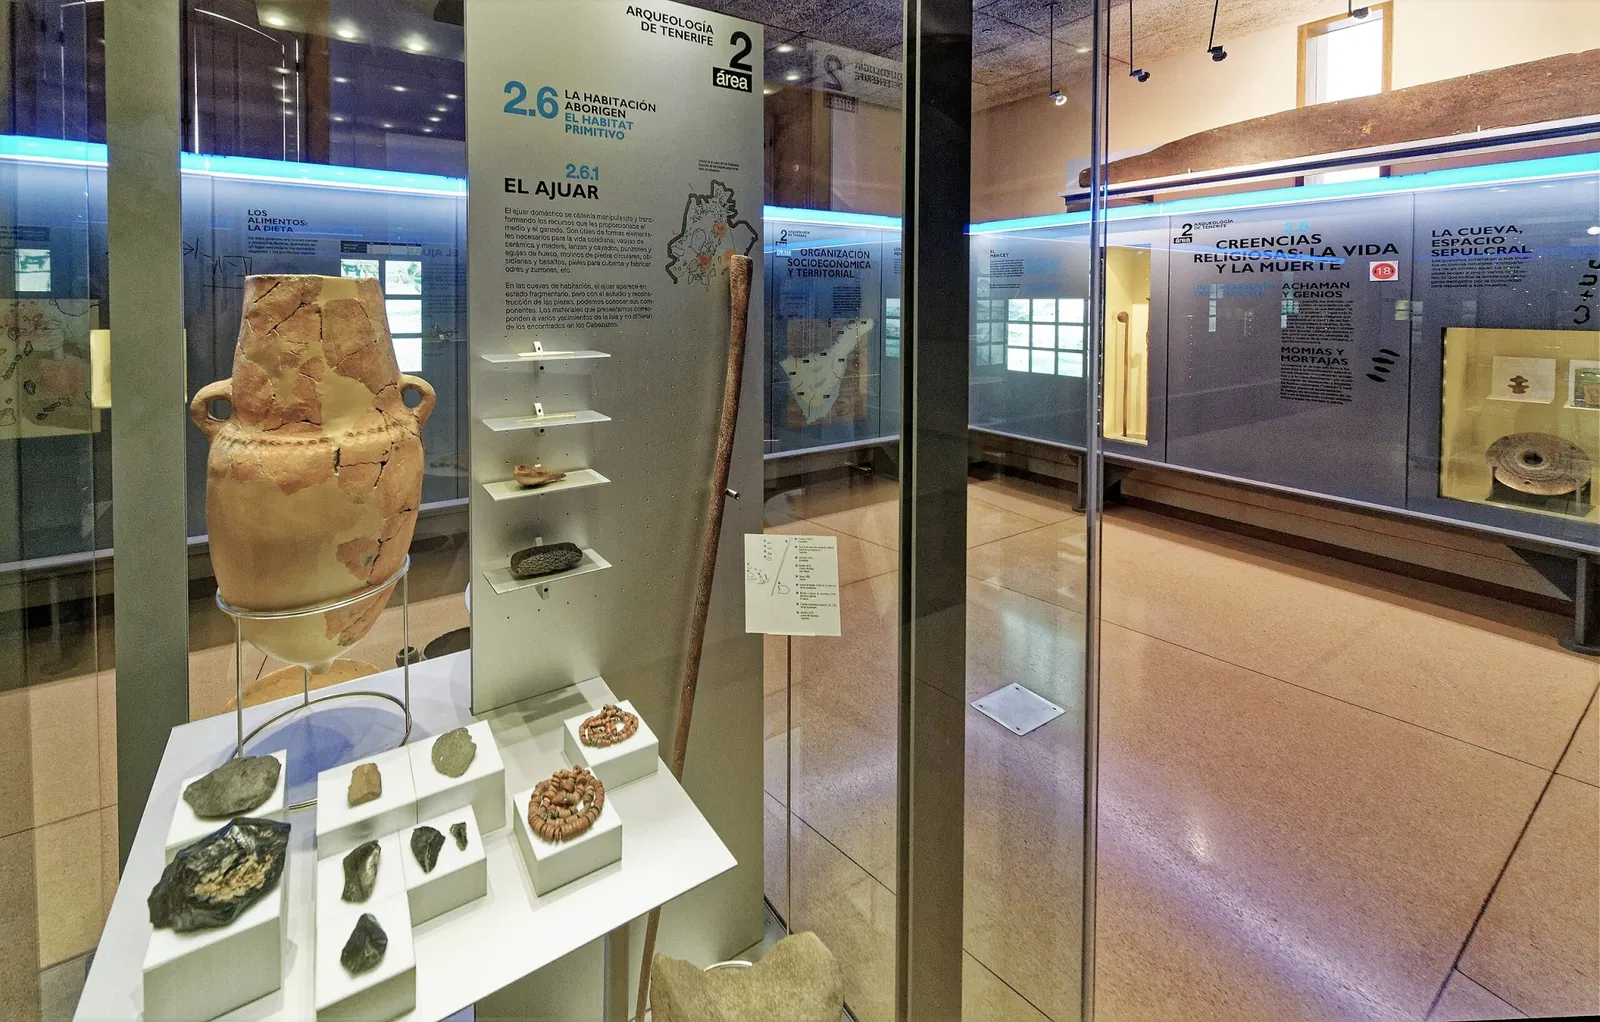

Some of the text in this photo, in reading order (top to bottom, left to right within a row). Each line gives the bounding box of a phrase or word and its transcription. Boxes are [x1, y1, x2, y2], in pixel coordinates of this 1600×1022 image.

[626, 5, 714, 34] ARQUEOLOGÍA
[641, 21, 714, 46] DE TENERIFE
[729, 30, 752, 72] 2
[716, 70, 748, 90] área
[504, 80, 559, 119] 2.6
[564, 90, 656, 112] LA HABITACIÓN
[564, 102, 626, 118] ABORIGEN
[564, 113, 634, 131] EL HABITAT
[564, 124, 625, 140] PRIMITIVO
[566, 164, 599, 180] 2.6.1
[504, 178, 599, 200] EL AJUAR
[248, 217, 308, 226] ALIMENTOS:
[248, 224, 262, 232] LA
[780, 230, 788, 242] 2
[1182, 223, 1193, 236] 2
[1432, 225, 1523, 237] LA CUEVA,
[1216, 234, 1322, 250] CREENCIAS
[1432, 236, 1505, 247] ESPACIO
[800, 249, 870, 259] ORGANIZACIÓN
[1310, 246, 1337, 258] LA
[1342, 243, 1400, 256] VIDA
[1431, 246, 1532, 256] SEPULCRAL
[788, 257, 872, 269] SOCIOECONÓMICA
[1216, 261, 1342, 274] Y LA MUERTE
[788, 268, 854, 278] Y TERRITORIAL
[1376, 266, 1390, 276] 18
[1282, 282, 1350, 290] ACHAMAN
[1294, 290, 1342, 298] GENIOS
[1281, 347, 1332, 356] MOMIAS
[1281, 355, 1348, 366] MORTAJAS
